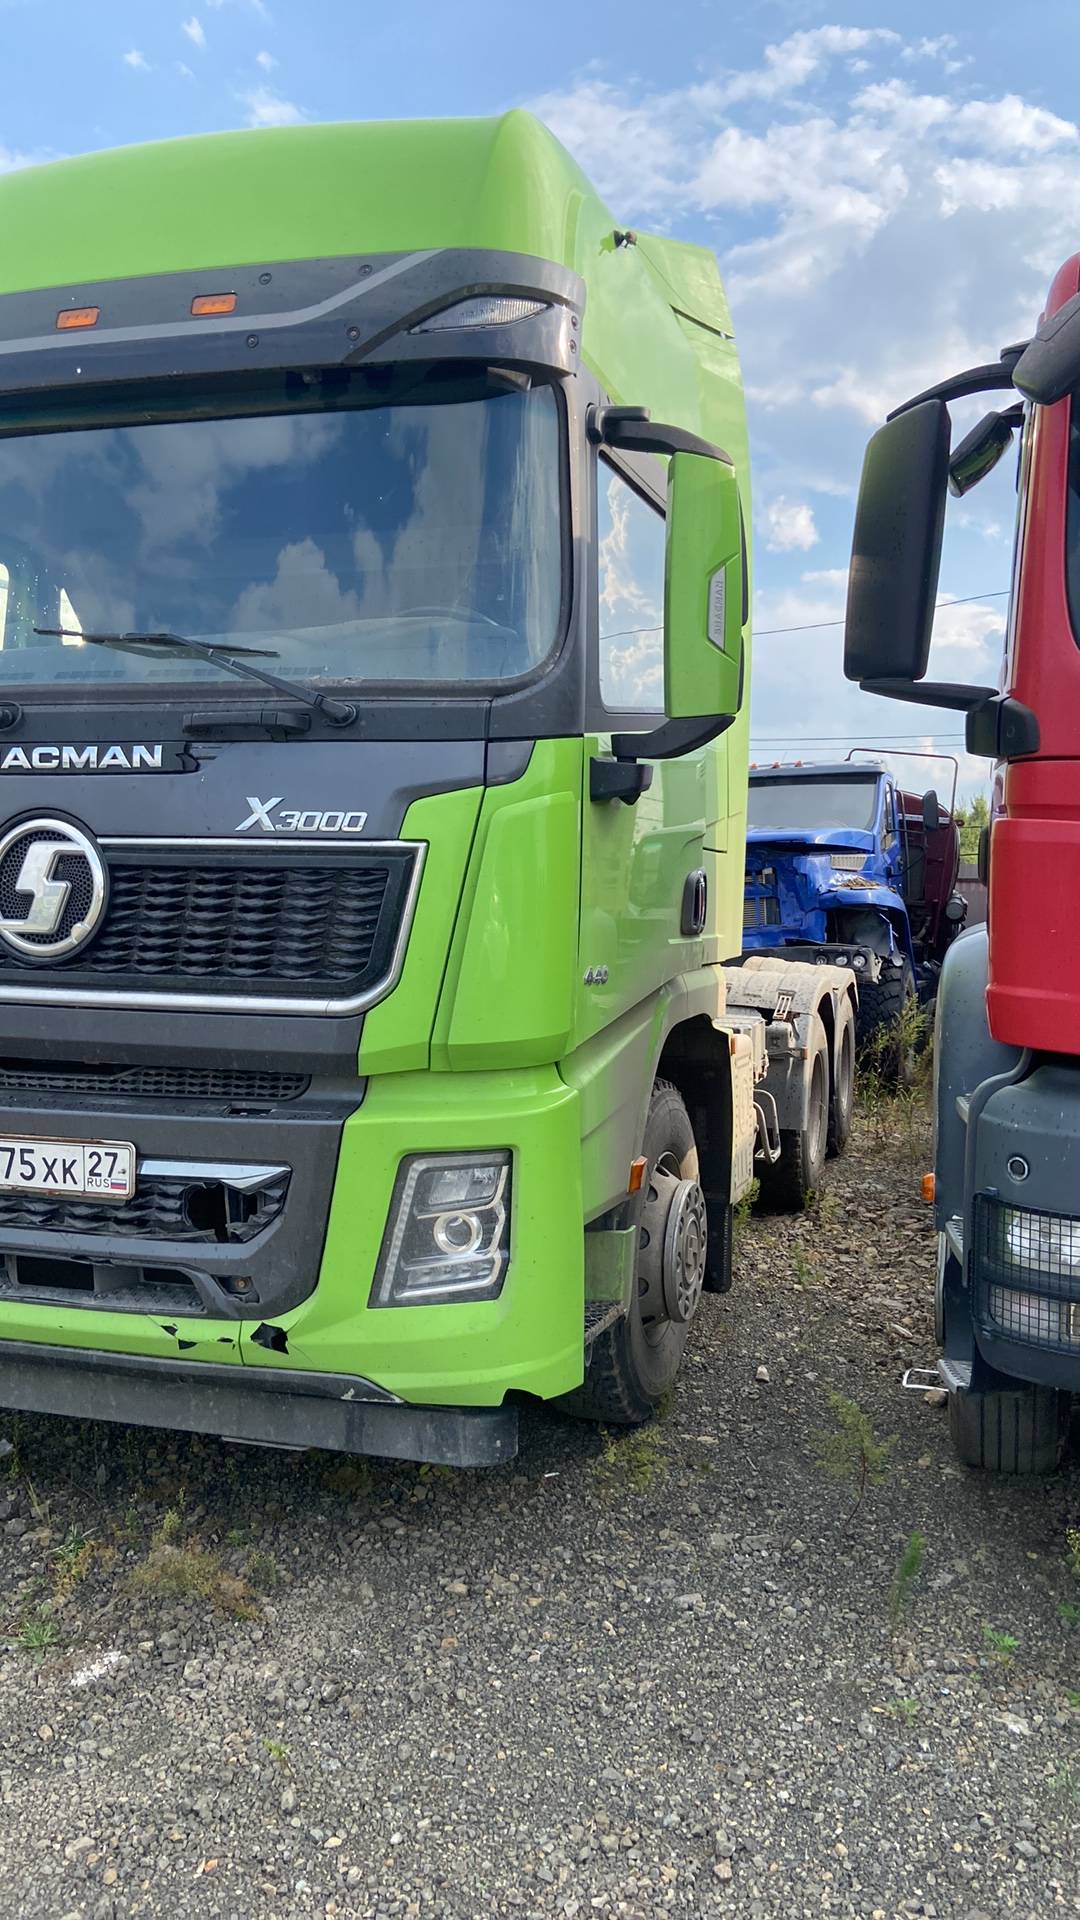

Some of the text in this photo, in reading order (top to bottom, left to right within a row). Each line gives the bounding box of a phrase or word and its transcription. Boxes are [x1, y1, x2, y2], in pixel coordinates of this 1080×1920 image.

[0, 745, 163, 769] ACMAN
[234, 797, 368, 832] X3000
[88, 1151, 118, 1178] 27
[87, 1177, 110, 1188] RUS
